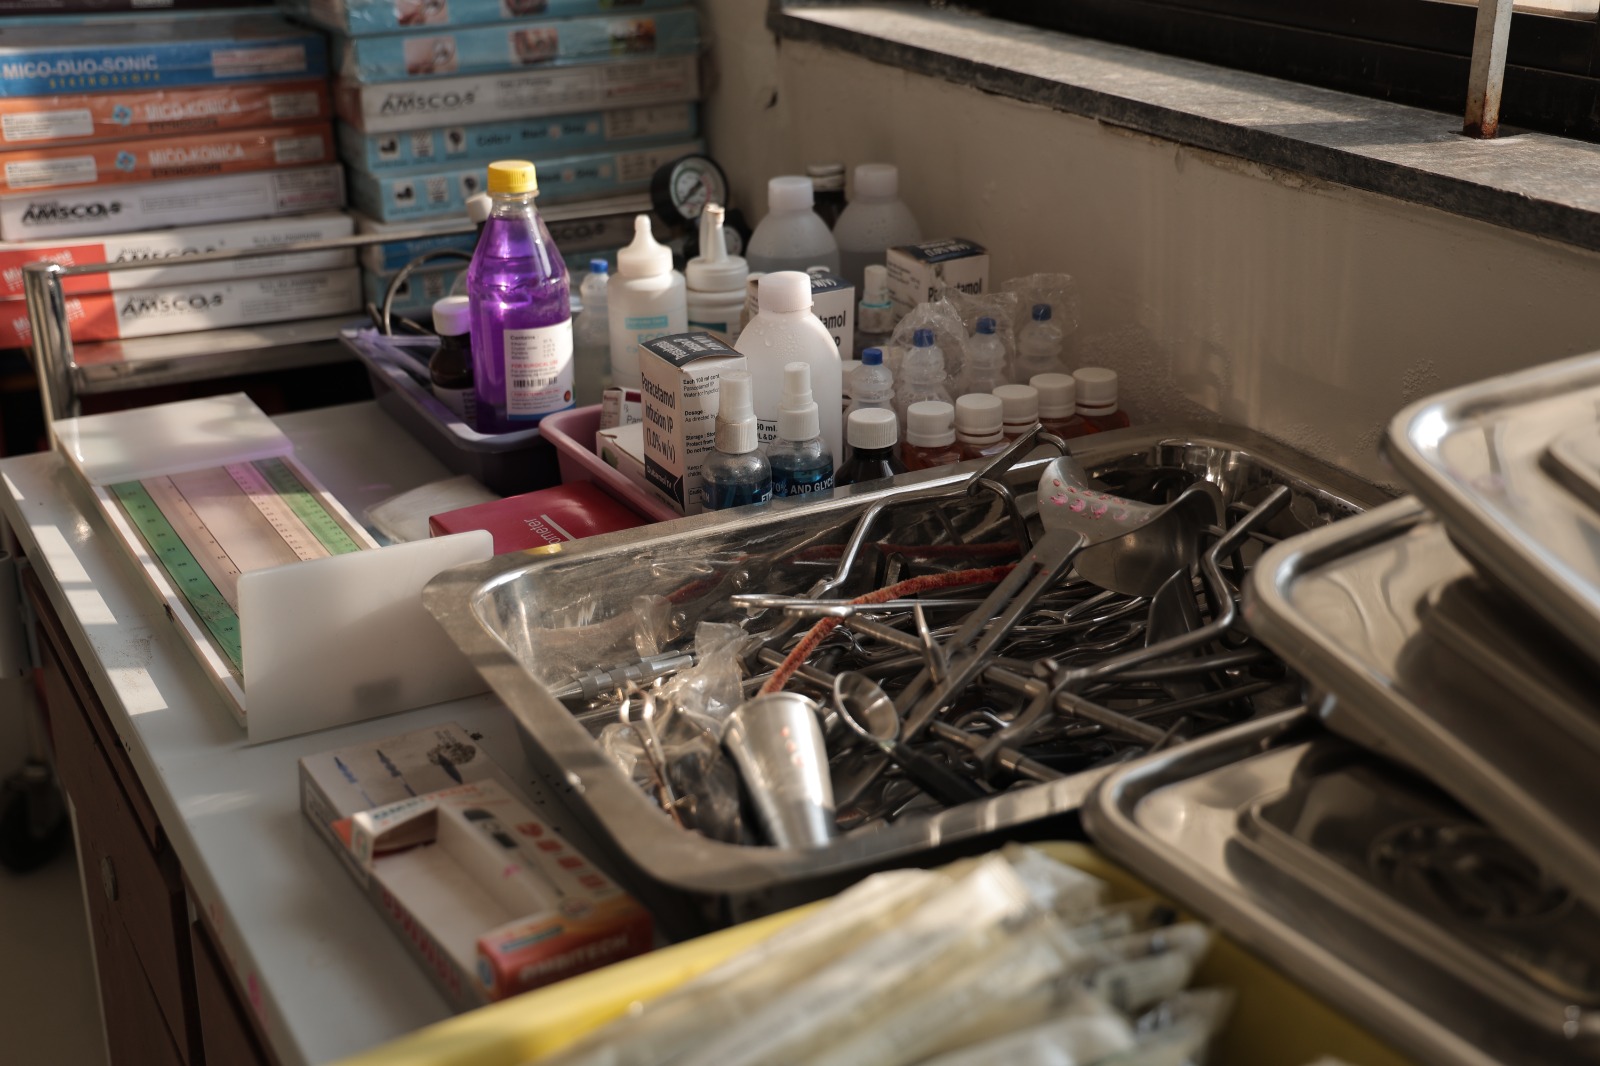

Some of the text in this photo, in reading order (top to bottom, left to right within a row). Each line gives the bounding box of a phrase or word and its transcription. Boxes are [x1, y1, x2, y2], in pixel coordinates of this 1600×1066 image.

[2, 54, 159, 80] MICO-DUO-SONIC
[144, 98, 241, 121] MICO-KONICA
[148, 144, 246, 167] MICO-KONICA
[641, 371, 676, 411] Paracetamol
[683, 382, 710, 392] Paracetamol
[645, 399, 668, 432] Infusion
[790, 483, 812, 495] AND
